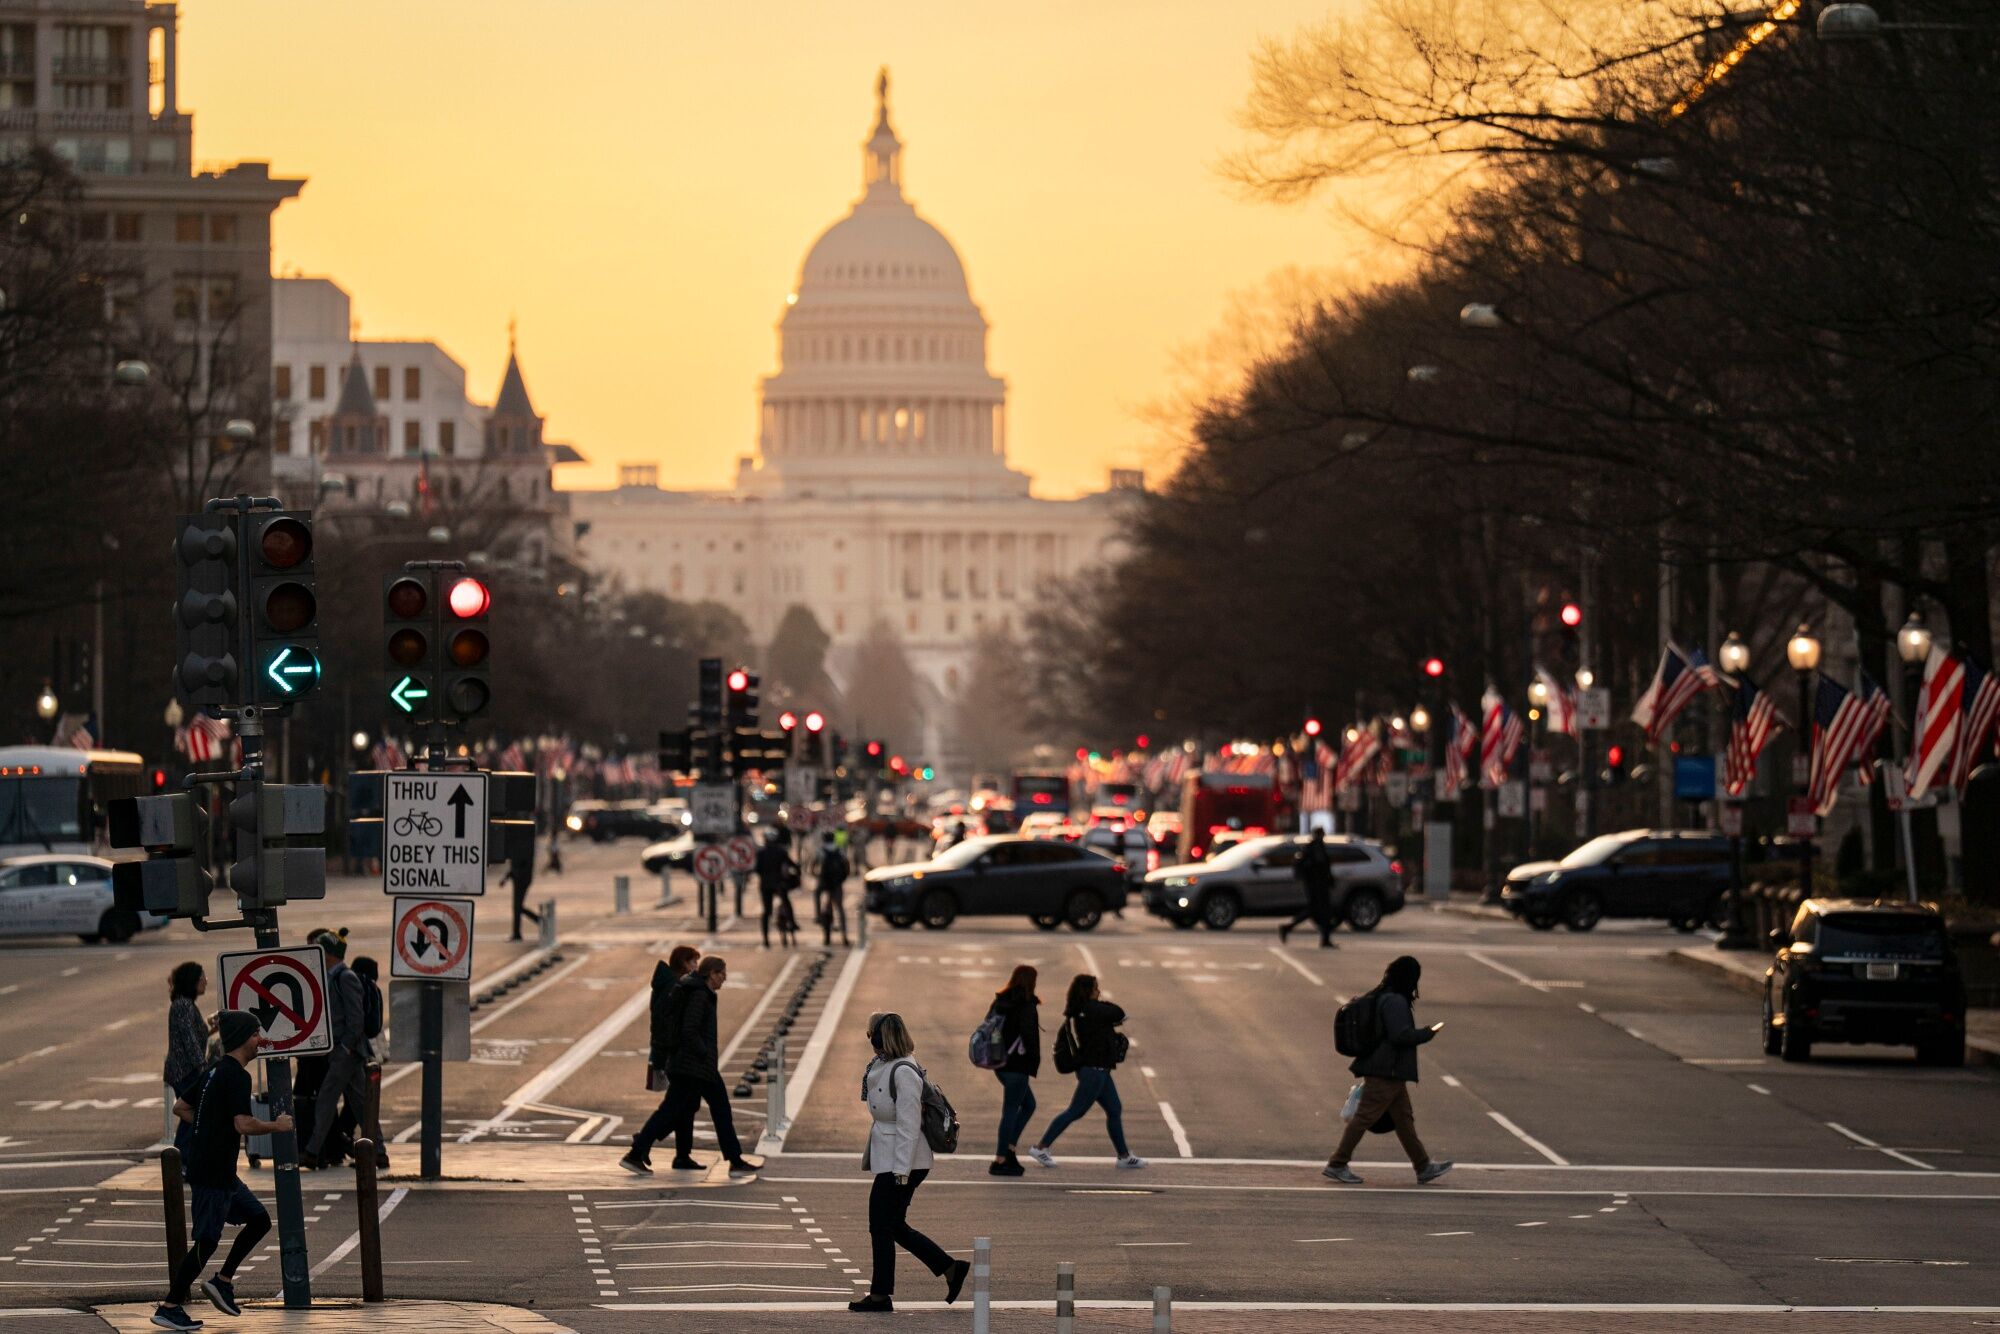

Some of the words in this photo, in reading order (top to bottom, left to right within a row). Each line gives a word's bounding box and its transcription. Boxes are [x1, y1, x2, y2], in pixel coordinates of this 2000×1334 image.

[392, 781, 437, 801] THRU
[390, 845, 435, 864] OBEY
[443, 845, 479, 864] THIS
[390, 868, 450, 887] SIGNAL
